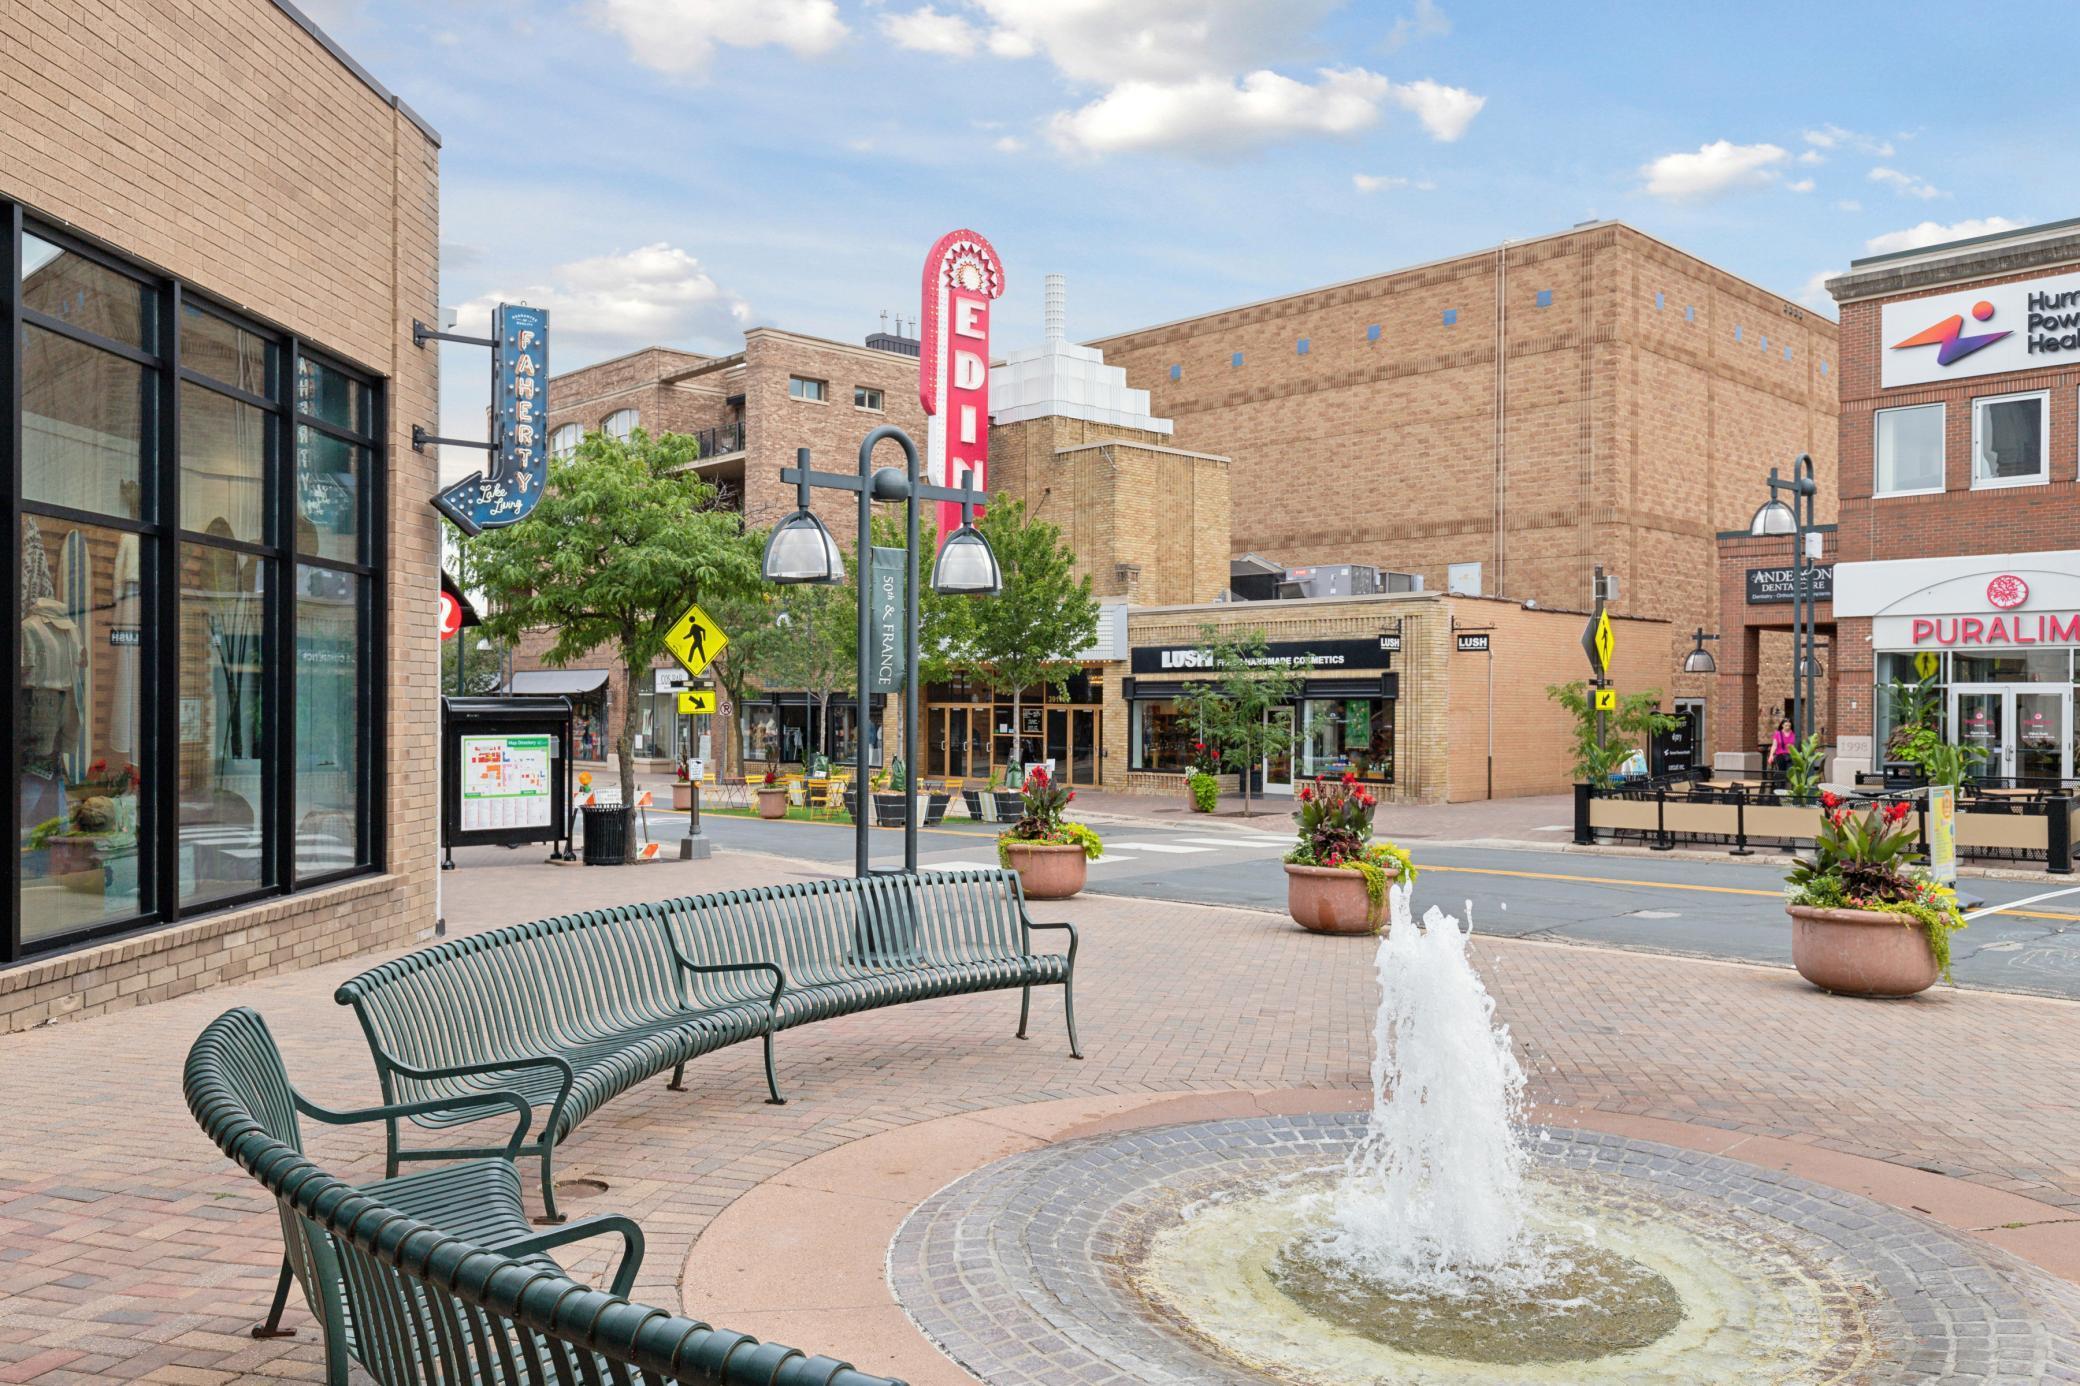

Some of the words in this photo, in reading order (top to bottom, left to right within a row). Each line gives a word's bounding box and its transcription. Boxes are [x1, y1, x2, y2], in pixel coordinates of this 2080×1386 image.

[516, 330, 535, 494] FAHERTY
[952, 297, 986, 522] EDIN
[477, 483, 507, 504] Lake
[490, 497, 523, 516] Living
[1754, 568, 1832, 583] ANDEON
[882, 575, 895, 601] 50th
[1762, 582, 1796, 592] DENTA
[882, 604, 895, 621] &
[1912, 614, 2080, 645] PURALIM
[1381, 637, 1400, 647] LUSH
[1458, 637, 1488, 647] LUSH
[878, 624, 895, 685] FRANCE
[1161, 650, 1214, 668] LUSH
